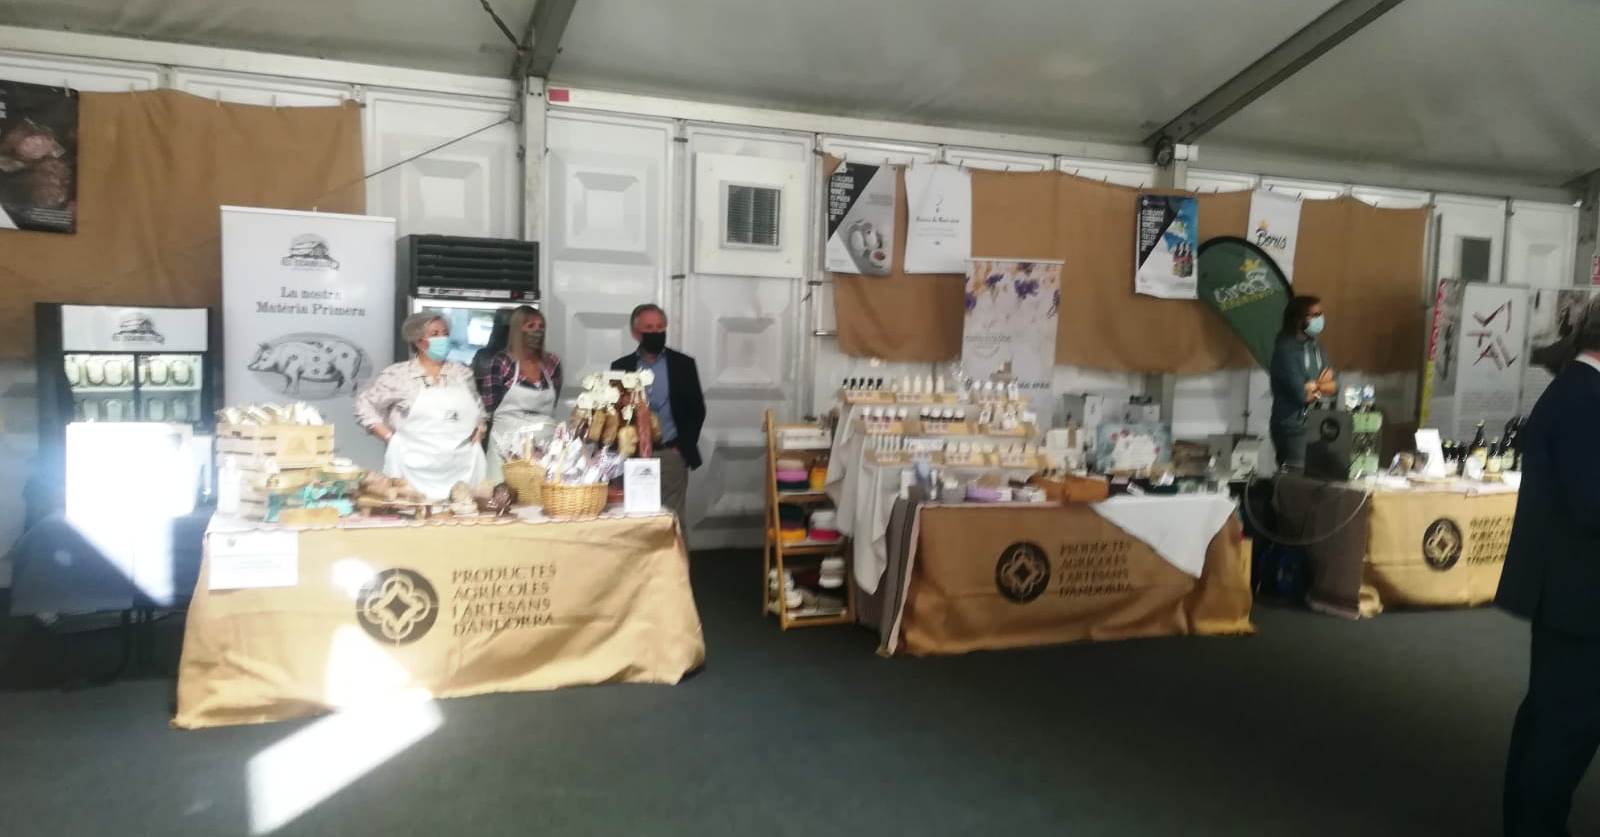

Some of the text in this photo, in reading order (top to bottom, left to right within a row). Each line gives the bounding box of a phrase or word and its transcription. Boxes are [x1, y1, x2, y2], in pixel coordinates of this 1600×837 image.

[281, 287, 297, 298] La
[312, 303, 366, 316] Primera
[452, 566, 557, 582] PRODUCTES
[454, 582, 550, 600] AGRÍCOLES
[463, 599, 551, 617] ARTESANS
[453, 615, 553, 635] D'ANDORRA
